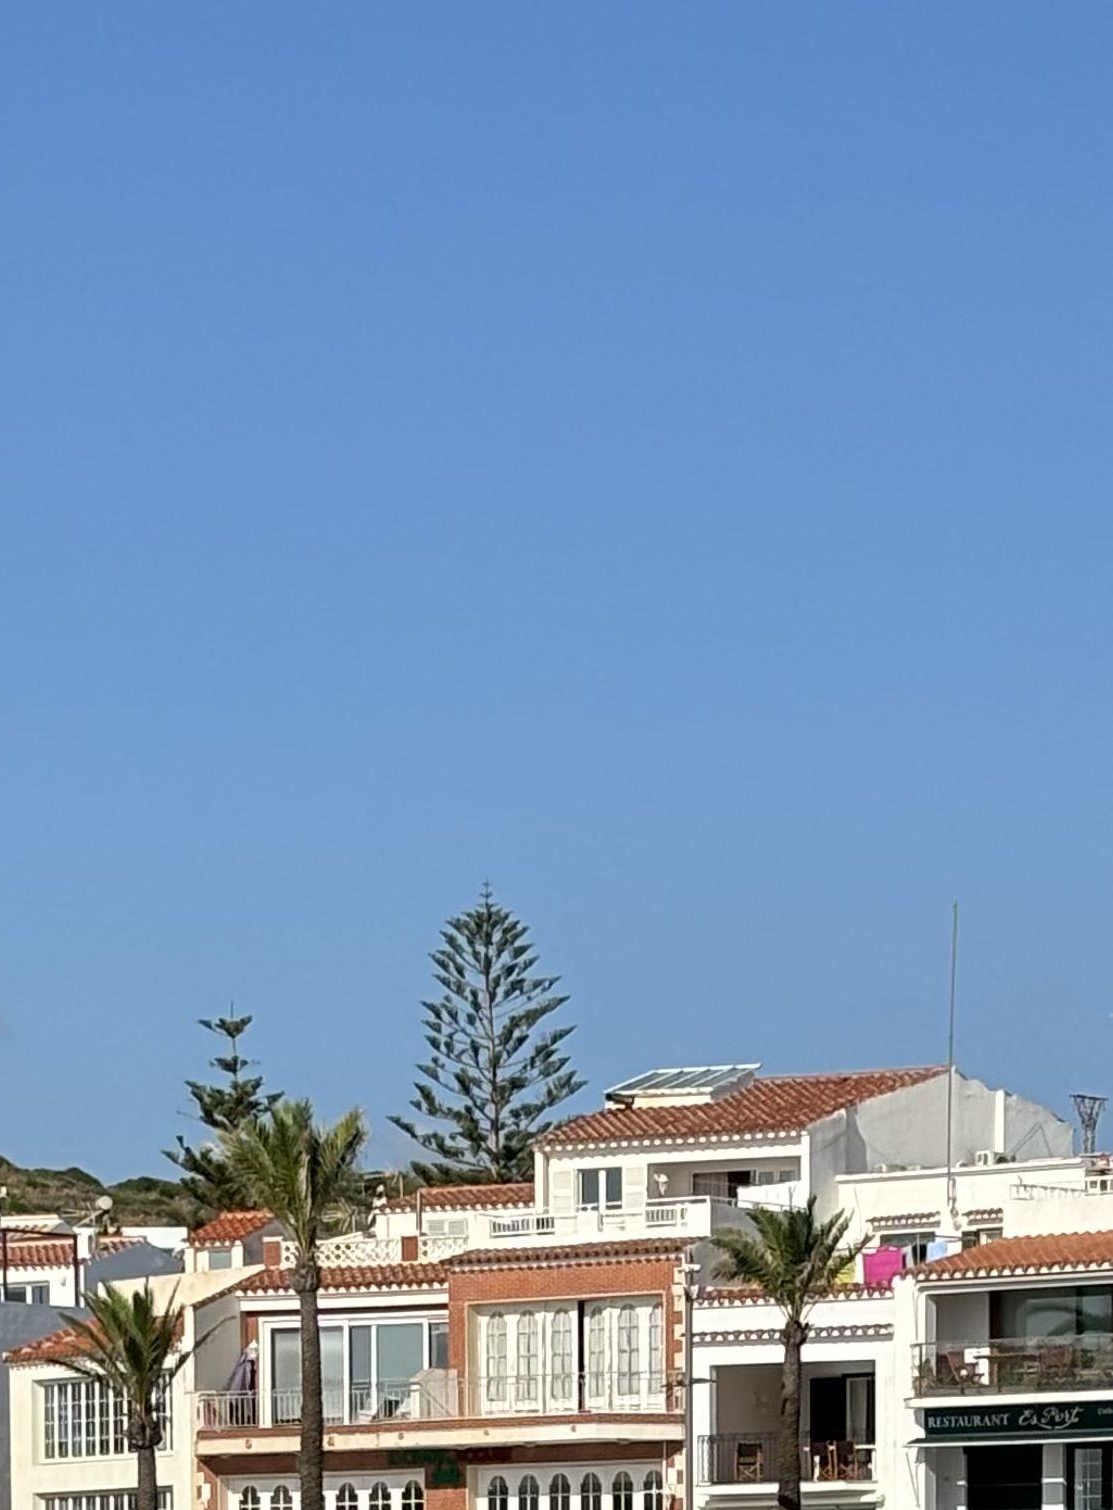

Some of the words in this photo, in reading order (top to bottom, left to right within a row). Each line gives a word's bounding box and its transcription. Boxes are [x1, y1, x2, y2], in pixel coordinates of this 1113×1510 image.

[927, 1412, 1010, 1429] RESTAURANT
[1018, 1409, 1037, 1426] Es
[1040, 1406, 1085, 1429] Port
